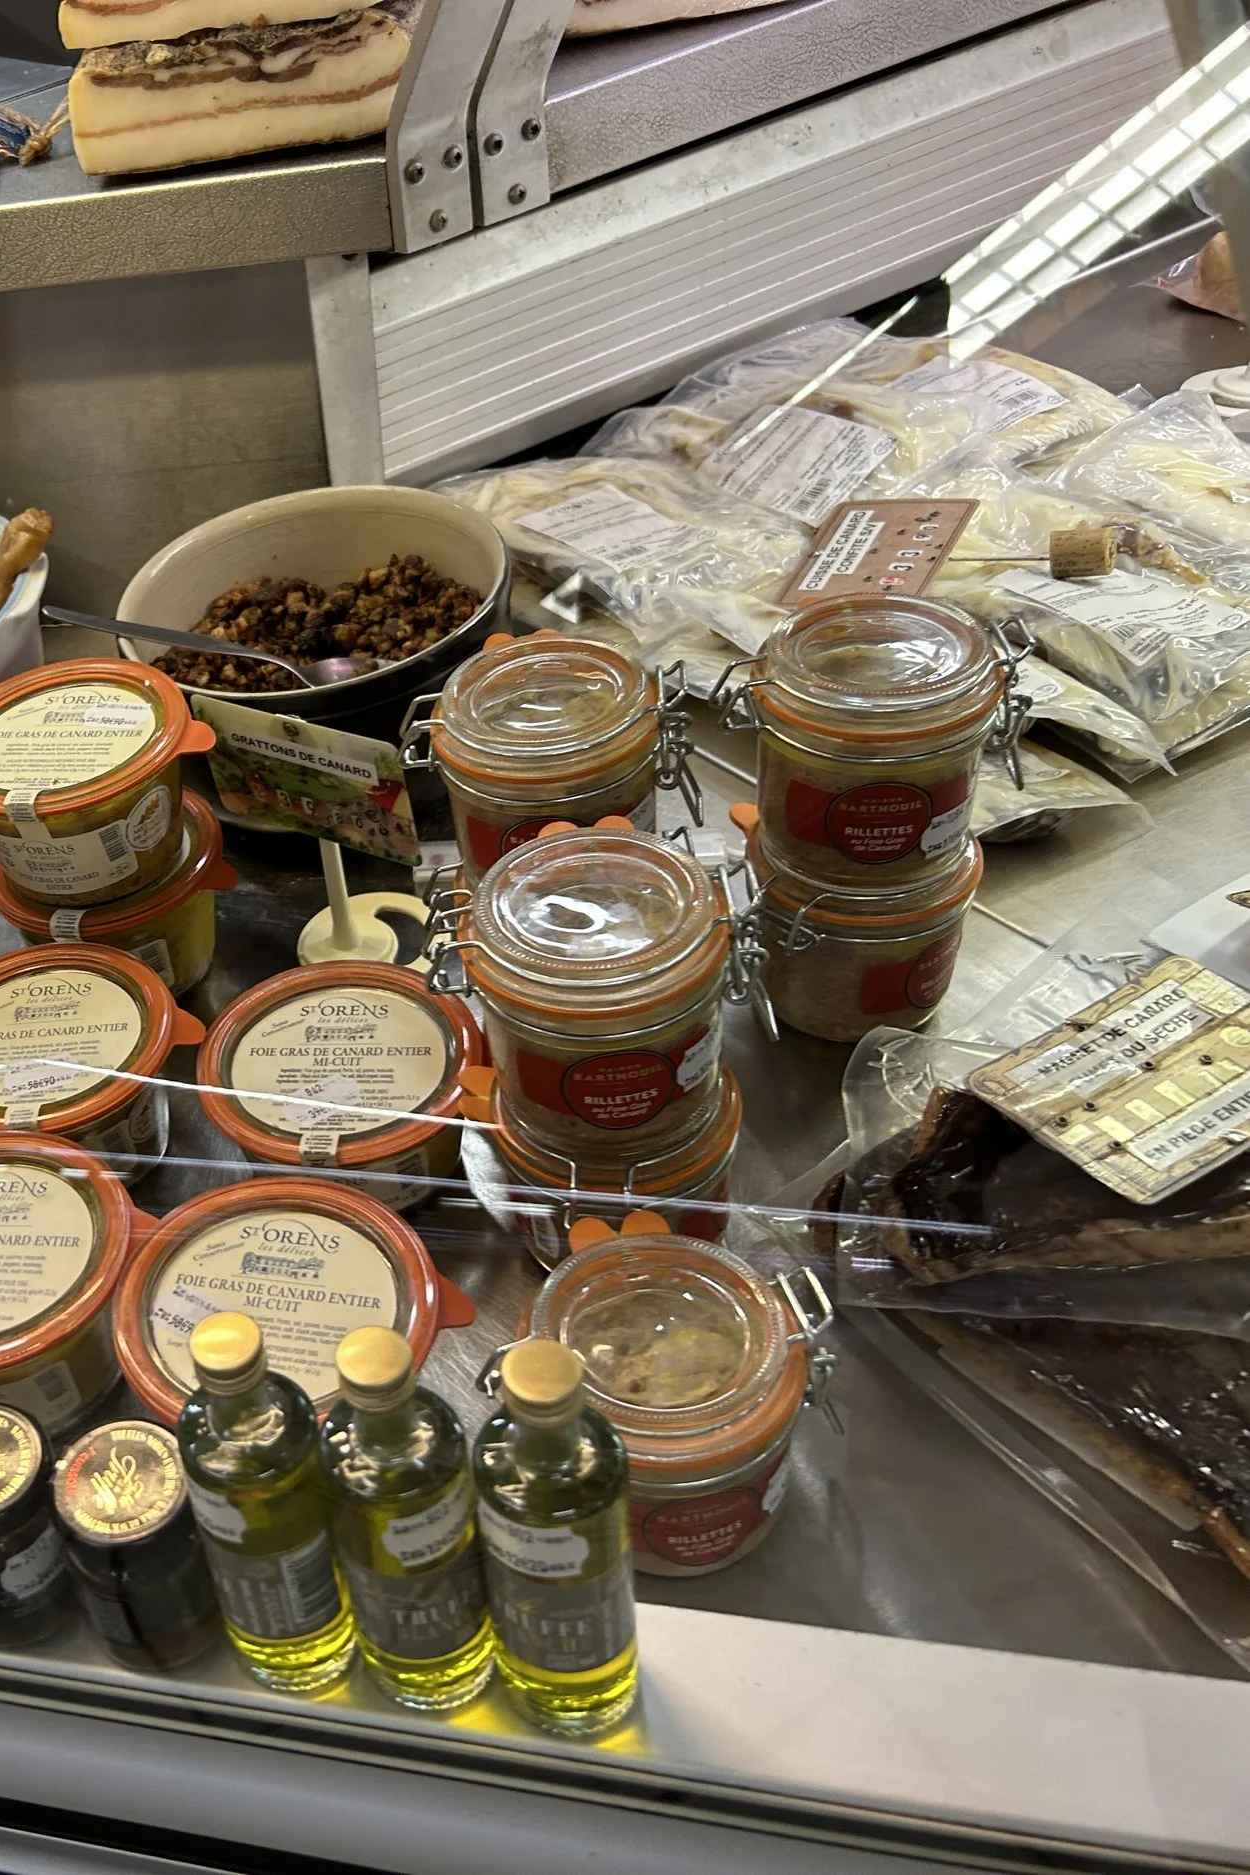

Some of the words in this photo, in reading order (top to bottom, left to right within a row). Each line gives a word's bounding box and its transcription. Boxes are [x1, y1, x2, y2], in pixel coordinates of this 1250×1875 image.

[827, 545, 843, 560] DE
[836, 511, 867, 545] CANARD
[15, 731, 41, 739] GRAS
[59, 730, 102, 738] CANARD
[104, 729, 143, 738] ENTIER
[230, 732, 297, 758] GRATTONS
[297, 750, 316, 764] DE
[317, 757, 371, 780] CANARD
[844, 825, 913, 836] RILLETTES
[1103, 1027, 1127, 1045] DE
[1125, 989, 1186, 1027] CANARD
[19, 1029, 36, 1039] DE
[37, 1025, 85, 1038] CANARD
[87, 1022, 128, 1034] ENTIER
[1120, 1041, 1146, 1058] OU
[1148, 1010, 1198, 1042] SECHE
[249, 1047, 277, 1057] FOIE
[279, 1047, 311, 1057] GRAS
[313, 1047, 329, 1056] DE
[332, 1047, 383, 1056] CANARD
[387, 1047, 432, 1056] ENTIER
[312, 1057, 363, 1067] MI-CUIT
[583, 1088, 658, 1105] RILLETTES
[1143, 1144, 1171, 1160] EN
[1168, 1117, 1217, 1148] PIECE
[33, 1236, 80, 1247] ENTIER
[176, 1274, 207, 1288] FOIE
[209, 1277, 244, 1292] GRAS
[247, 1282, 265, 1293] DE
[268, 1285, 326, 1302] CANARD
[328, 1293, 382, 1309] ENTIER
[243, 1295, 302, 1313] MI-CUIT
